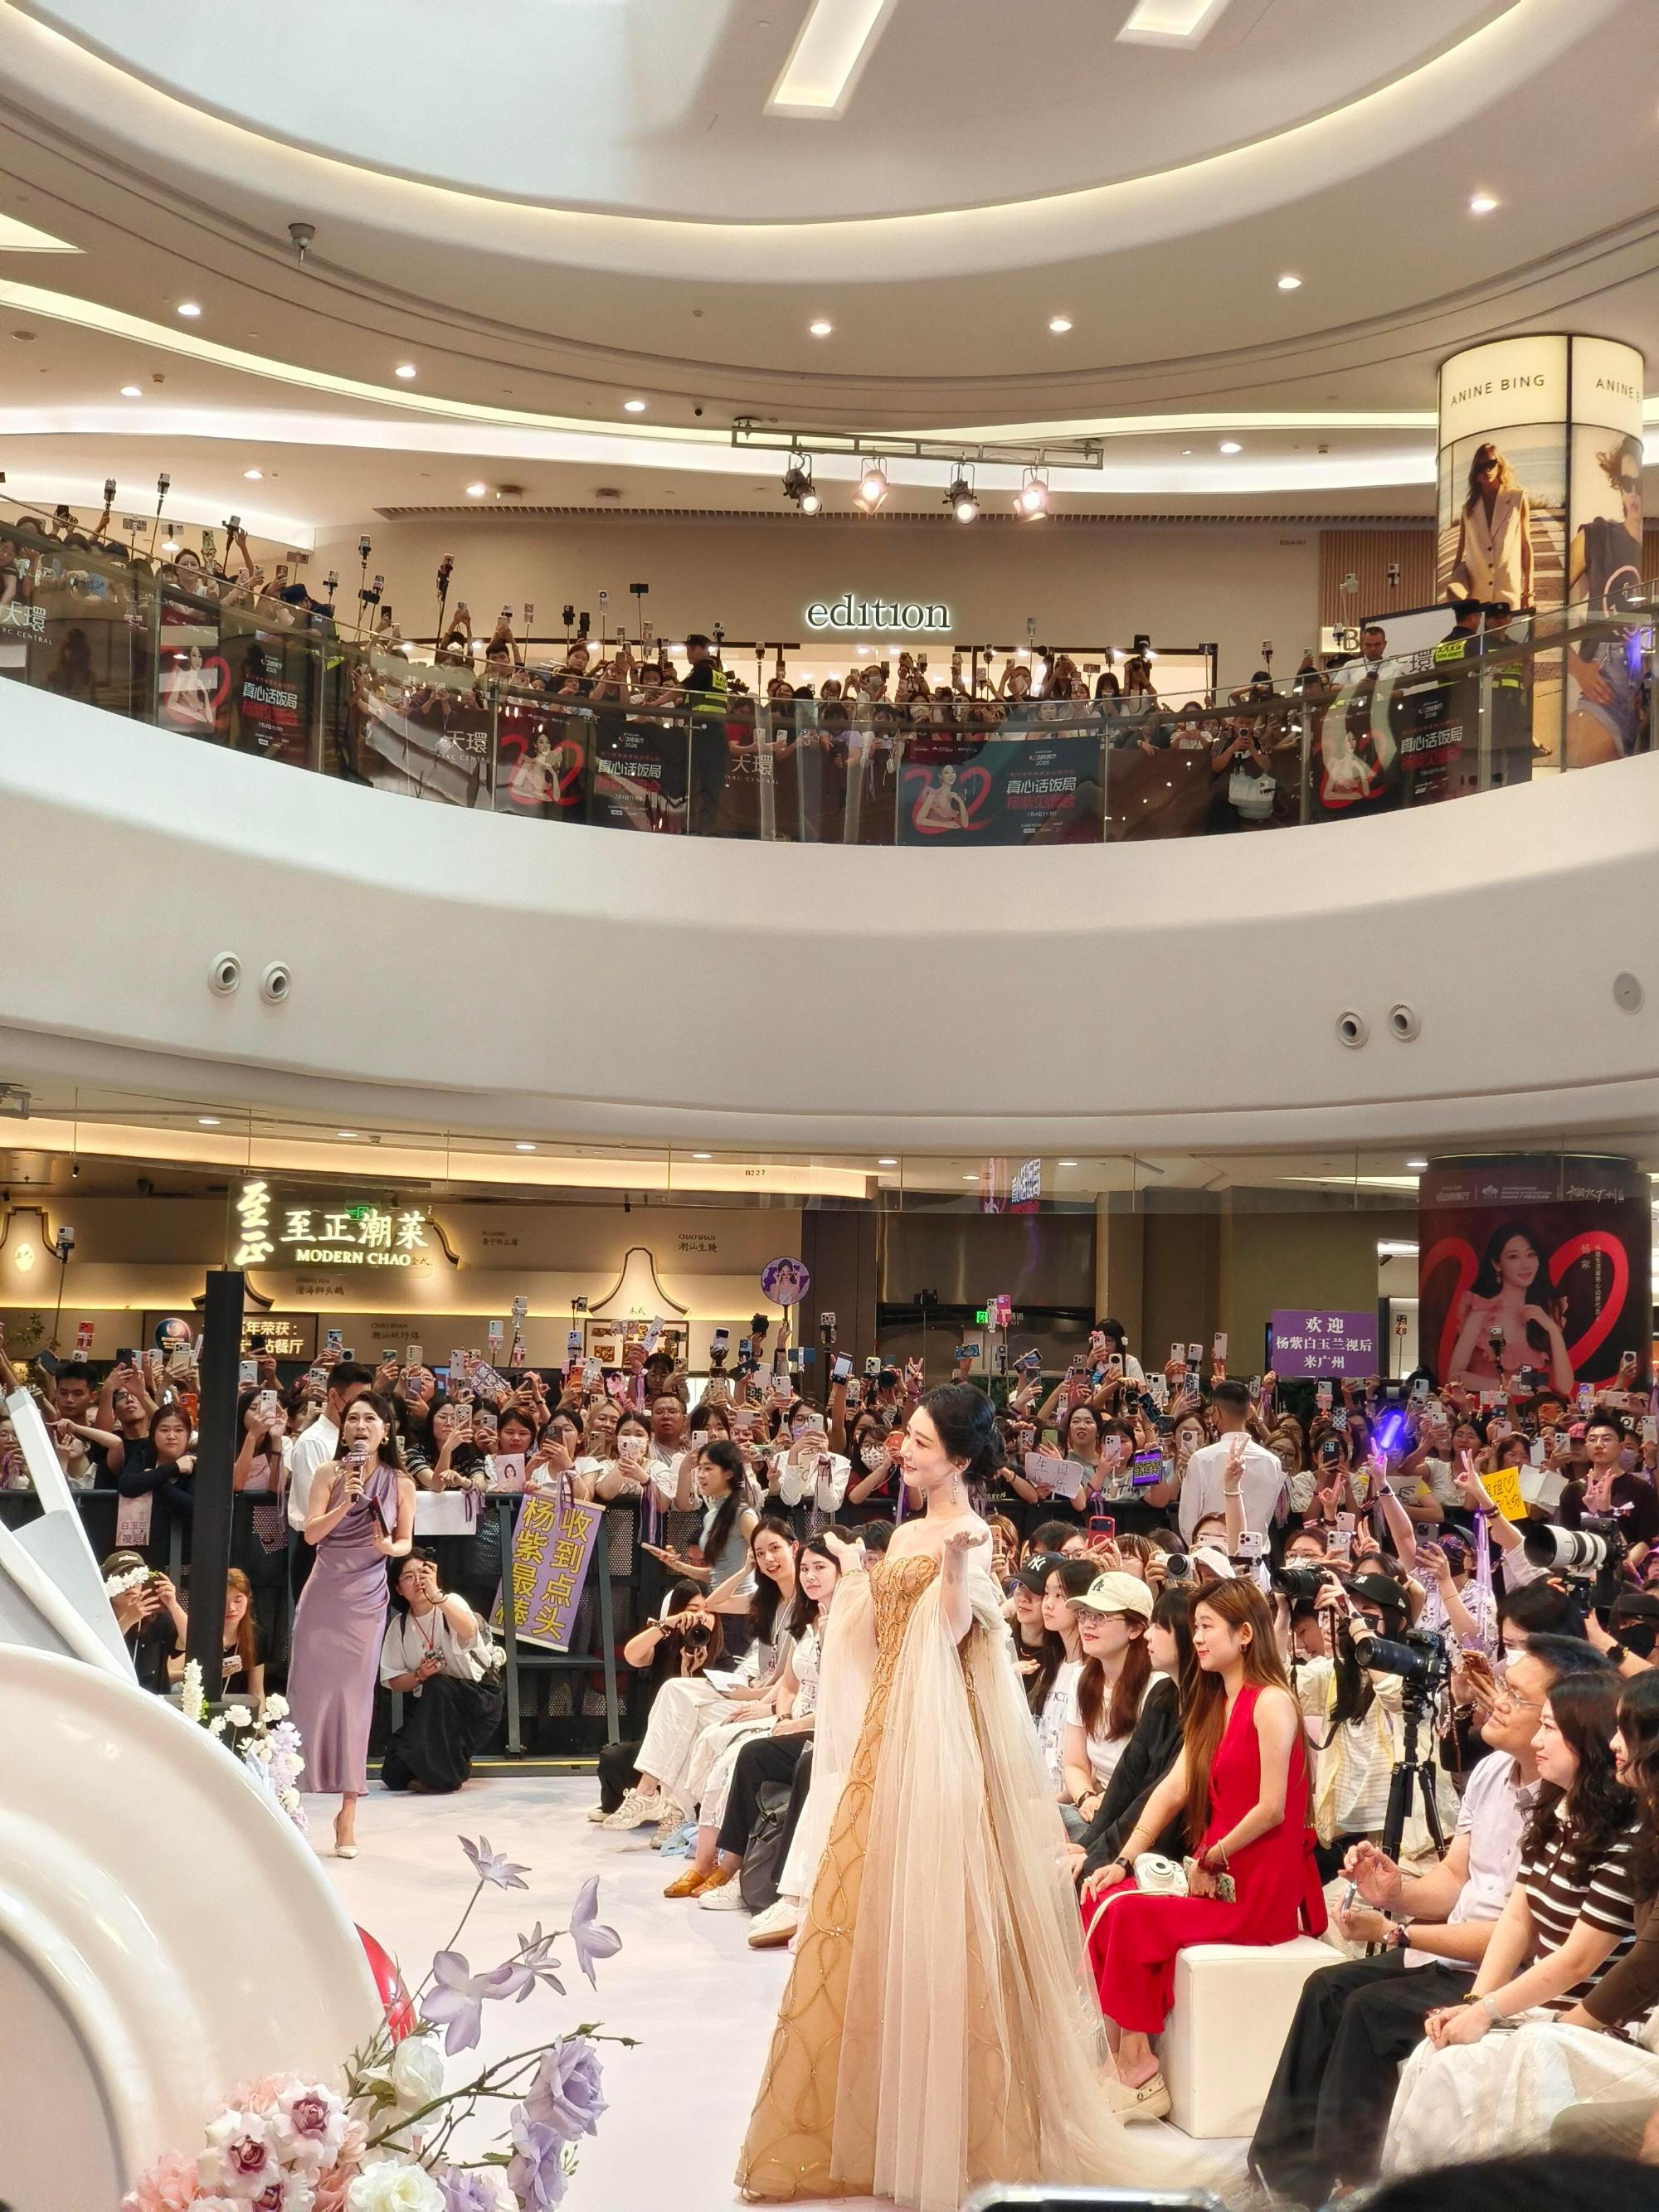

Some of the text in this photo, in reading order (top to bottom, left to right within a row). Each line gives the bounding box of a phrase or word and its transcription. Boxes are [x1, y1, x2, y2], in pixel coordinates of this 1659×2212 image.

[1451, 374, 1545, 406] ANINE BING
[1595, 377, 1634, 399] ANINE
[806, 594, 951, 630] edition
[17, 630, 53, 646] CENTRAL
[243, 682, 298, 710] 真心话饭局
[1400, 726, 1463, 755] 真心话饭局
[598, 759, 662, 779] 真心话饭局
[1006, 776, 1077, 795] 真心话饭局
[279, 1208, 429, 1249] 至正潮菜
[295, 1248, 411, 1266] MODERN CHAO
[1305, 1316, 1345, 1334] 欢迎
[1275, 1335, 1373, 1353] 杨紫白玉兰视后
[1303, 1355, 1345, 1369] 来广州
[495, 1495, 557, 1627] 杨紫最棒
[1028, 1554, 1046, 1572] NY
[532, 1506, 594, 1641] 收到点头
